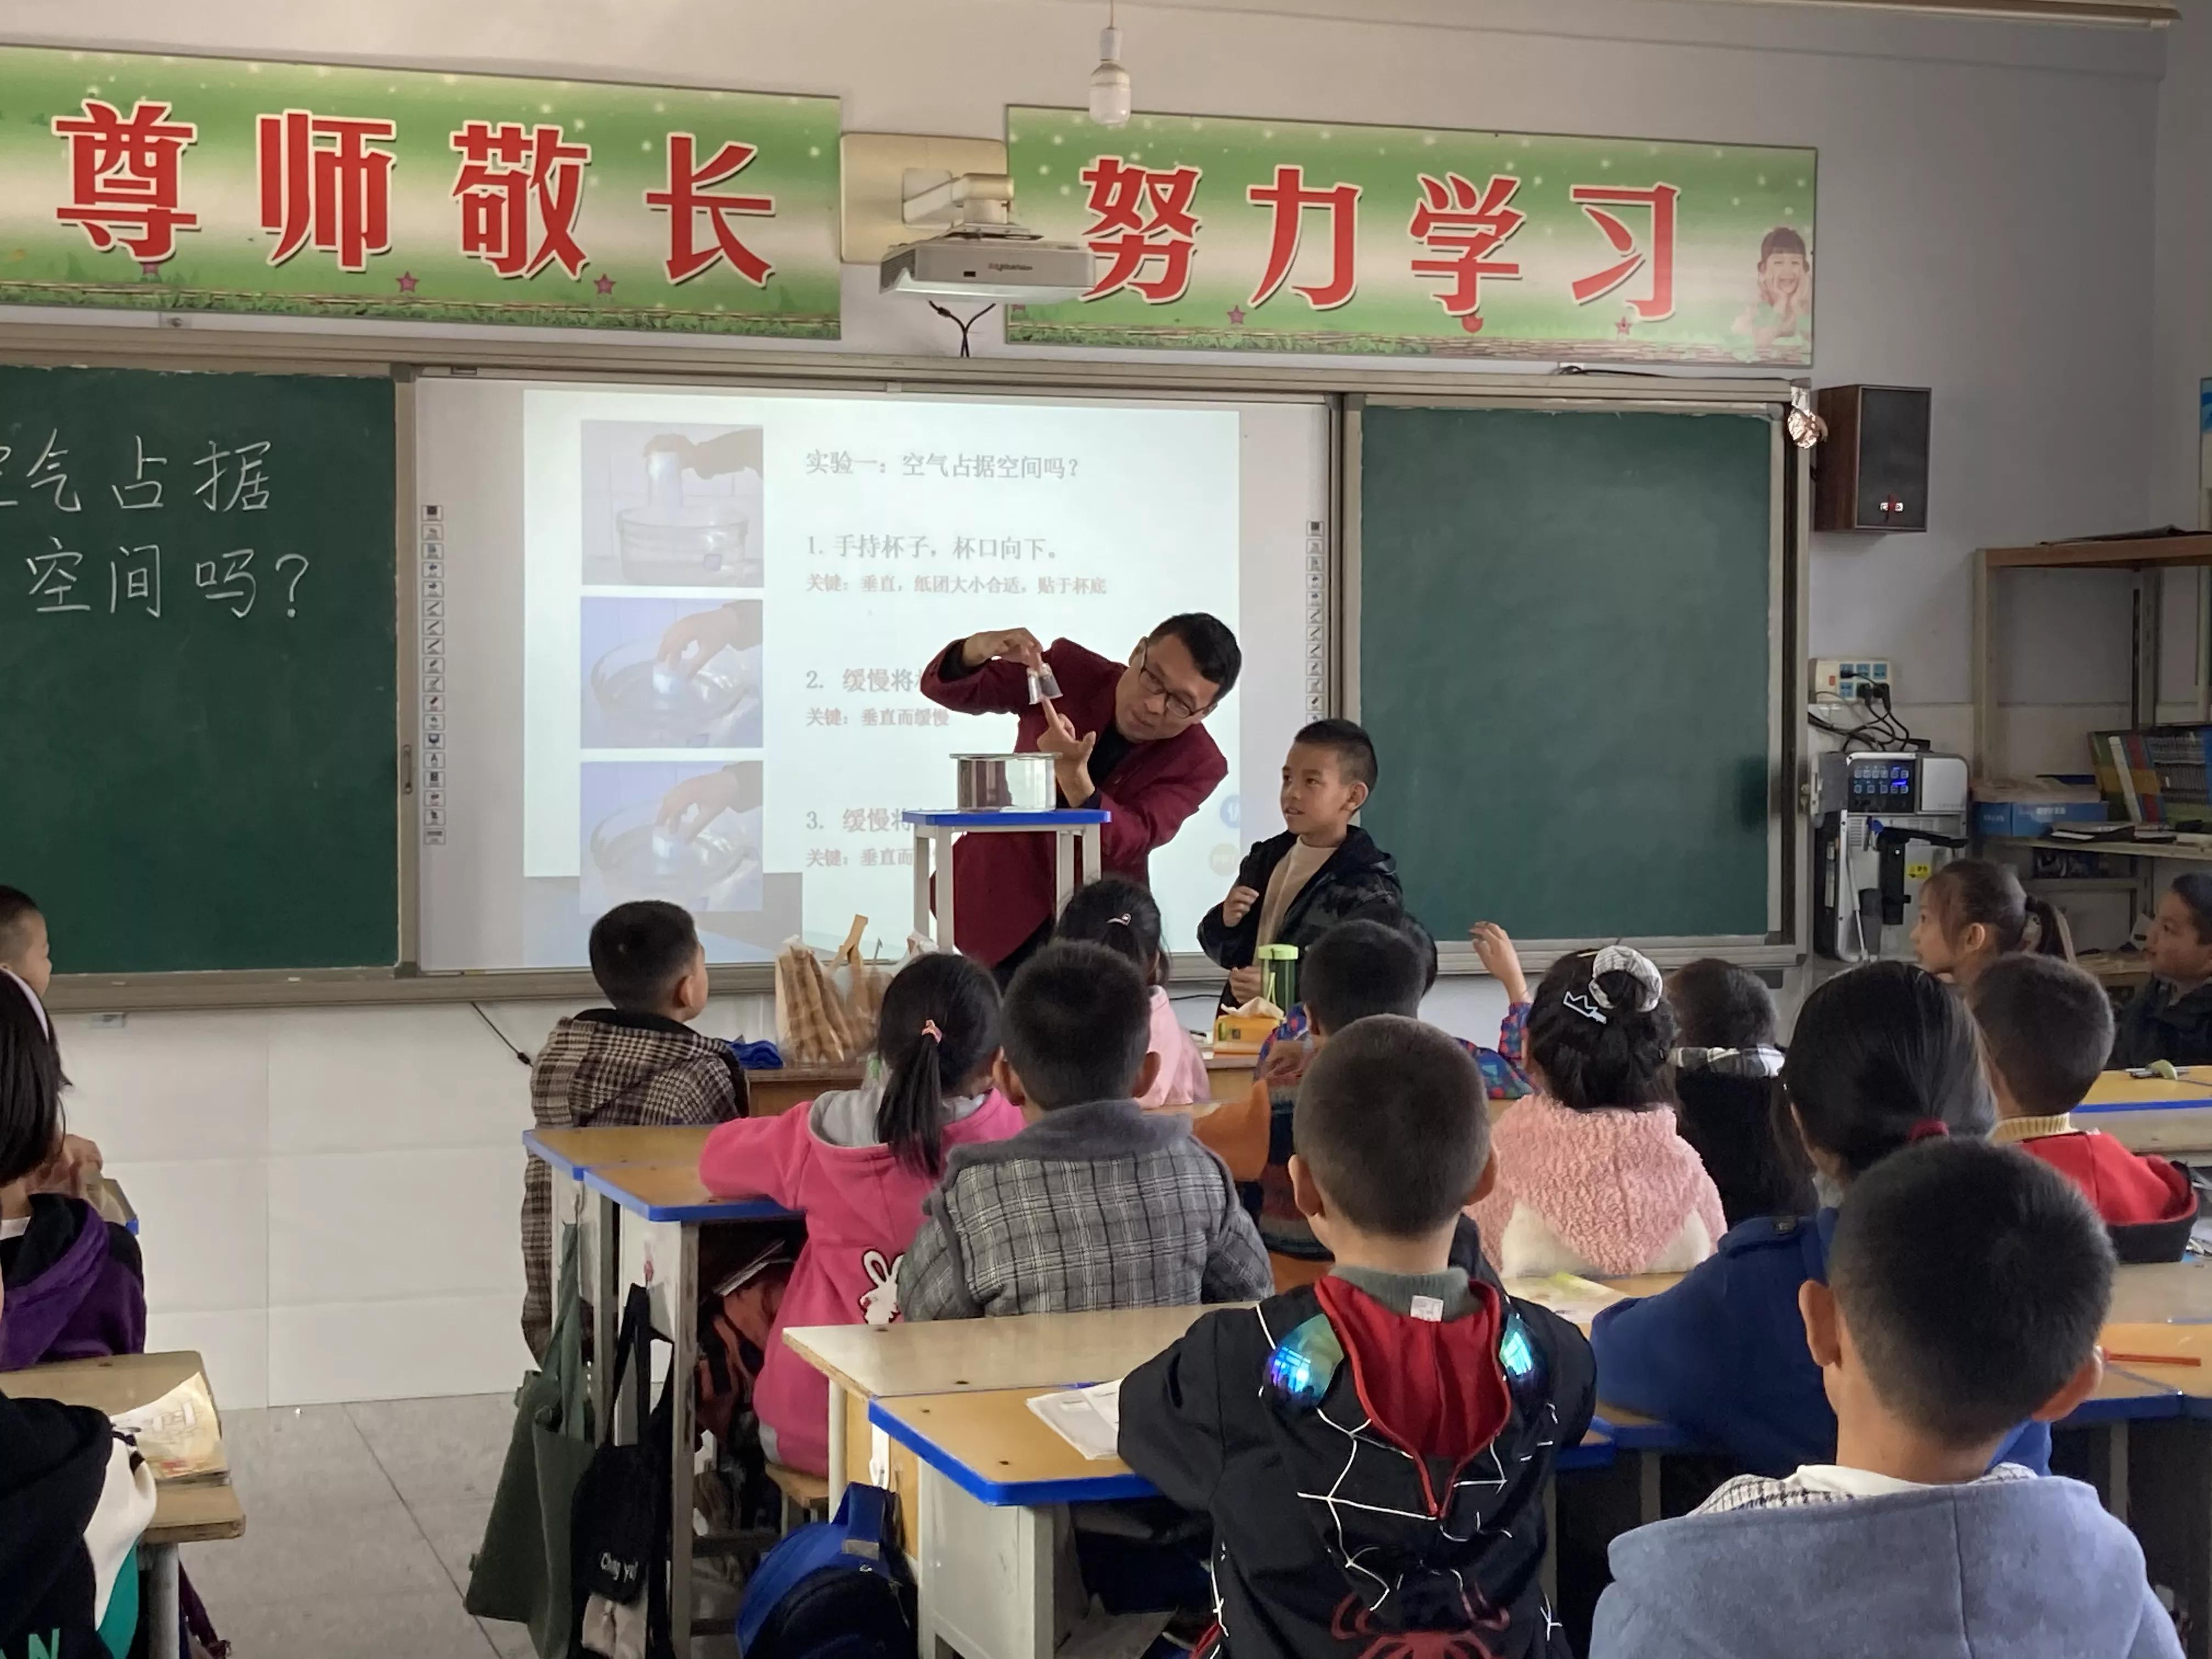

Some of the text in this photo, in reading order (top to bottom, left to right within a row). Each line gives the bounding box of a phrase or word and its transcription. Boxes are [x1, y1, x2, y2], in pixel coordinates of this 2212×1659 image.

[52, 98, 776, 287] 尊师敬长
[1080, 156, 1681, 321] 努力学习
[26, 536, 309, 618] 空间吗？
[843, 668, 922, 693] 缓慢将
